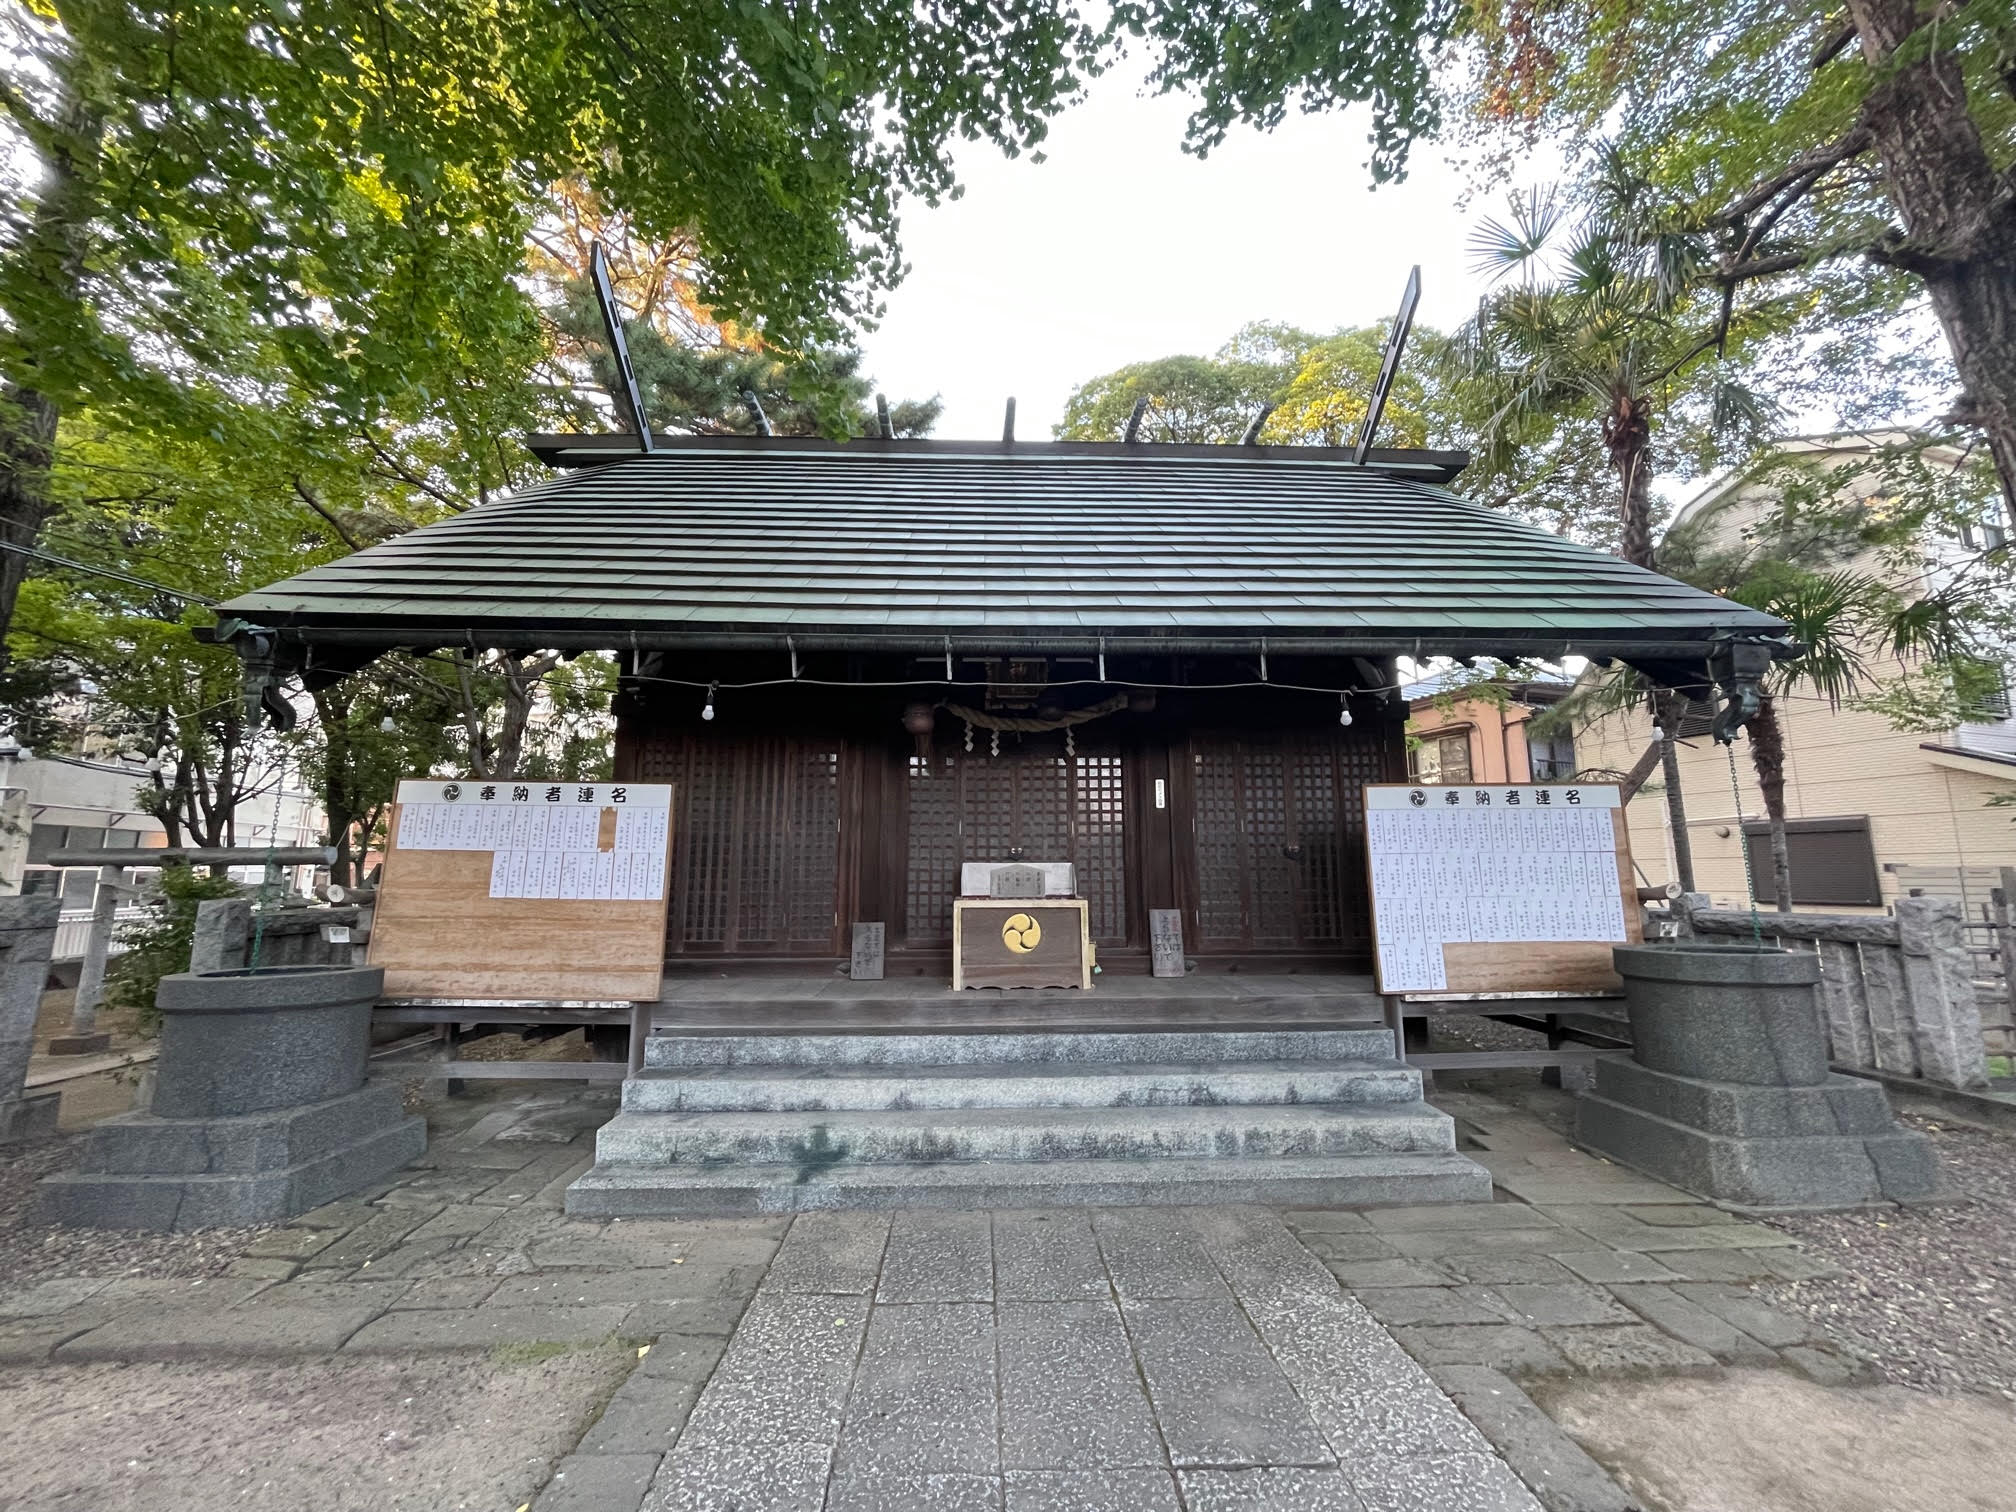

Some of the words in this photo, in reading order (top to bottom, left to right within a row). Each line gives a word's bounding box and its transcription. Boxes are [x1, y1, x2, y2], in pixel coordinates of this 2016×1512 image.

[479, 785, 628, 803] 奉納者連名
[1444, 789, 1581, 806] 奉納者連名
